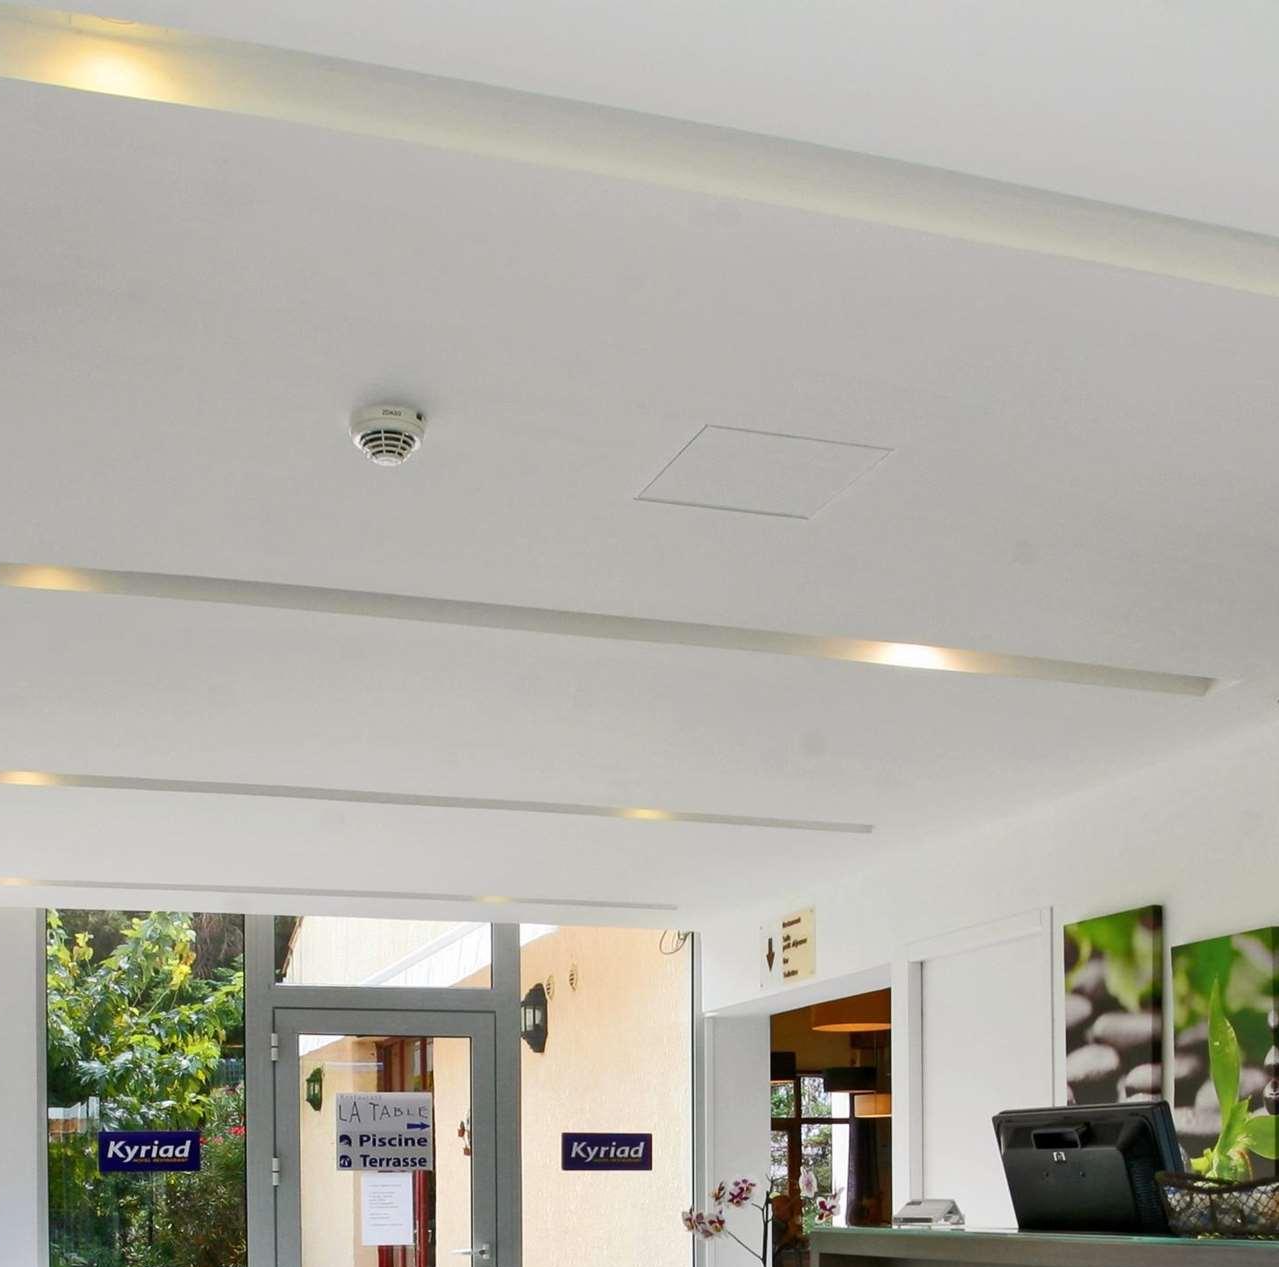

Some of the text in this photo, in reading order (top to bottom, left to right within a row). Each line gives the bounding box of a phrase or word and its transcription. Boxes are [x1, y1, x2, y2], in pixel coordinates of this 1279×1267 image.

[338, 1101, 428, 1123] LA TABLE
[107, 1140, 192, 1163] Kyriad
[359, 1134, 428, 1147] Piscine
[360, 1154, 427, 1168] Terrasse
[571, 1141, 645, 1163] Kyriad
